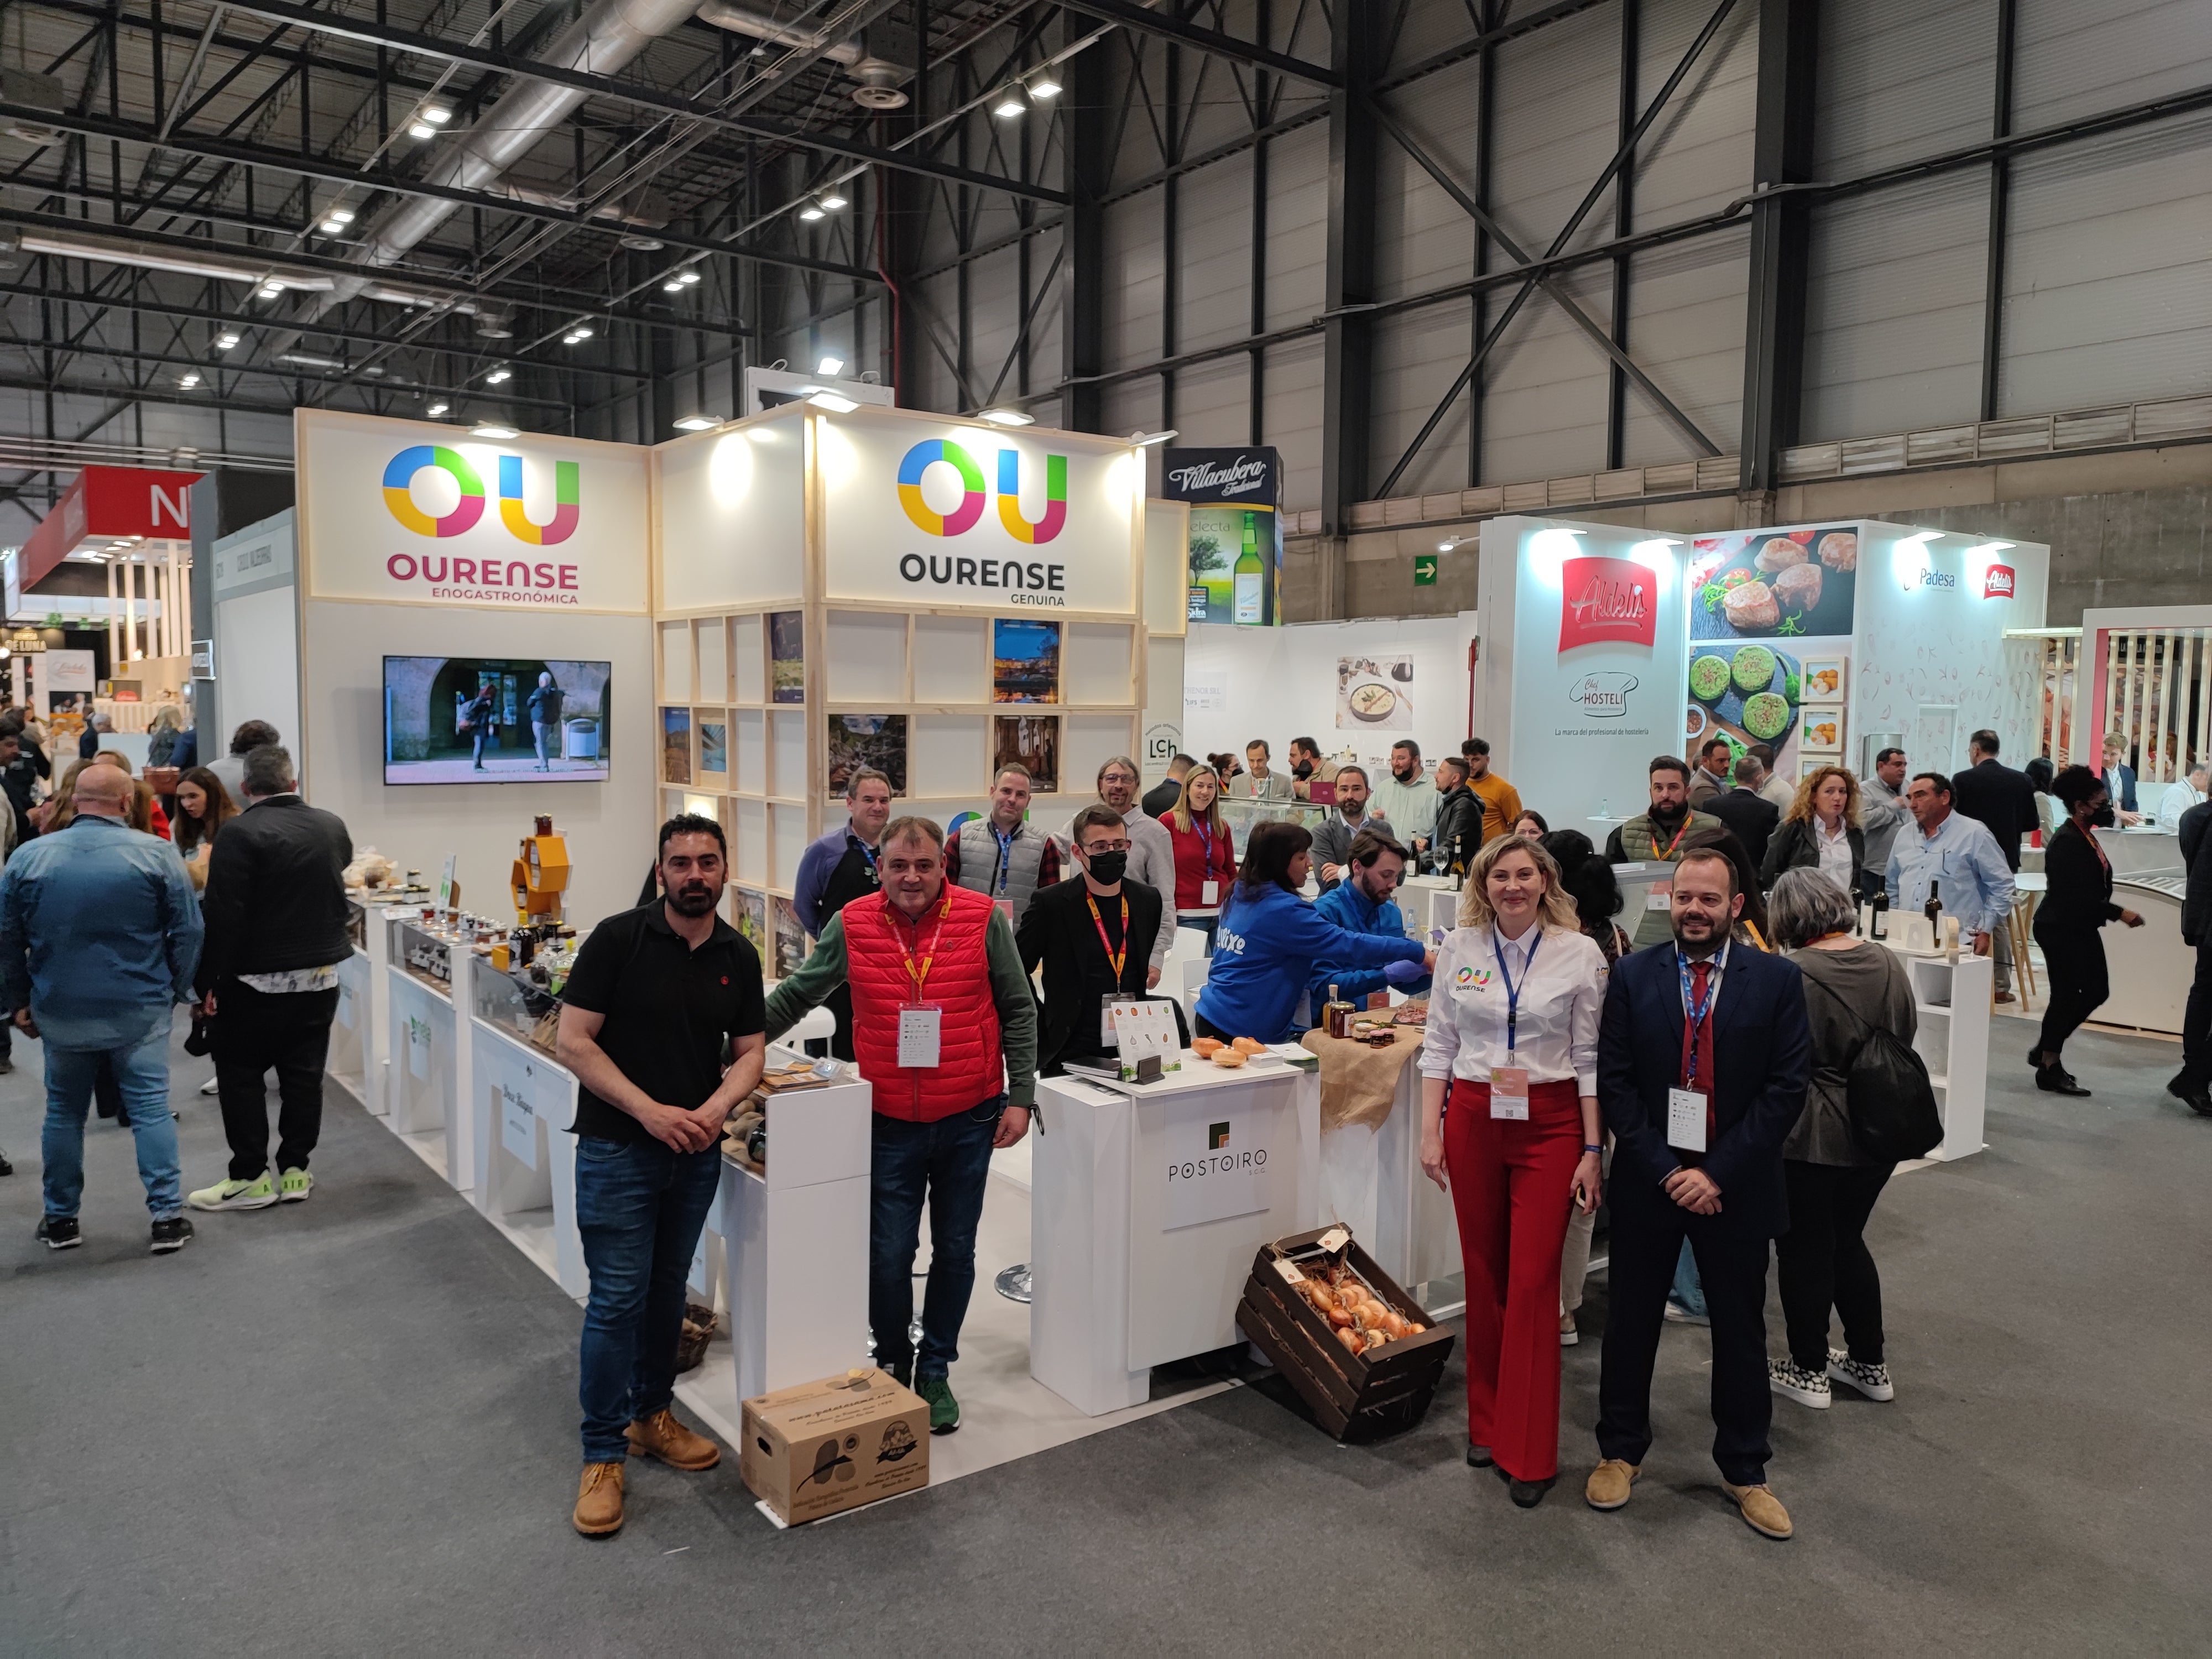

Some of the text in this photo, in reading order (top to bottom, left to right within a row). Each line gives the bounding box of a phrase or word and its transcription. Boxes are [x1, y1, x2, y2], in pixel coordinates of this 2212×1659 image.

[1168, 455, 1267, 492] Villacubera
[382, 445, 580, 545] OU
[897, 439, 1067, 544] OU
[1190, 520, 1230, 532] electa
[387, 554, 579, 589] OURENSE
[900, 554, 1065, 591] OURENSE
[1920, 568, 1955, 587] Padesa
[432, 588, 579, 604] ENOGASTRONÓMICA
[1011, 593, 1065, 607] GENUINA
[1569, 575, 1648, 623] Aldelis
[19, 640, 47, 652] LUNA
[1584, 693, 1623, 705] HOSTELI
[1588, 728, 1618, 736] profesional
[1457, 966, 1491, 985] OU
[1455, 984, 1486, 993] OURENSE
[1169, 1149, 1267, 1182] POSTOIRO
